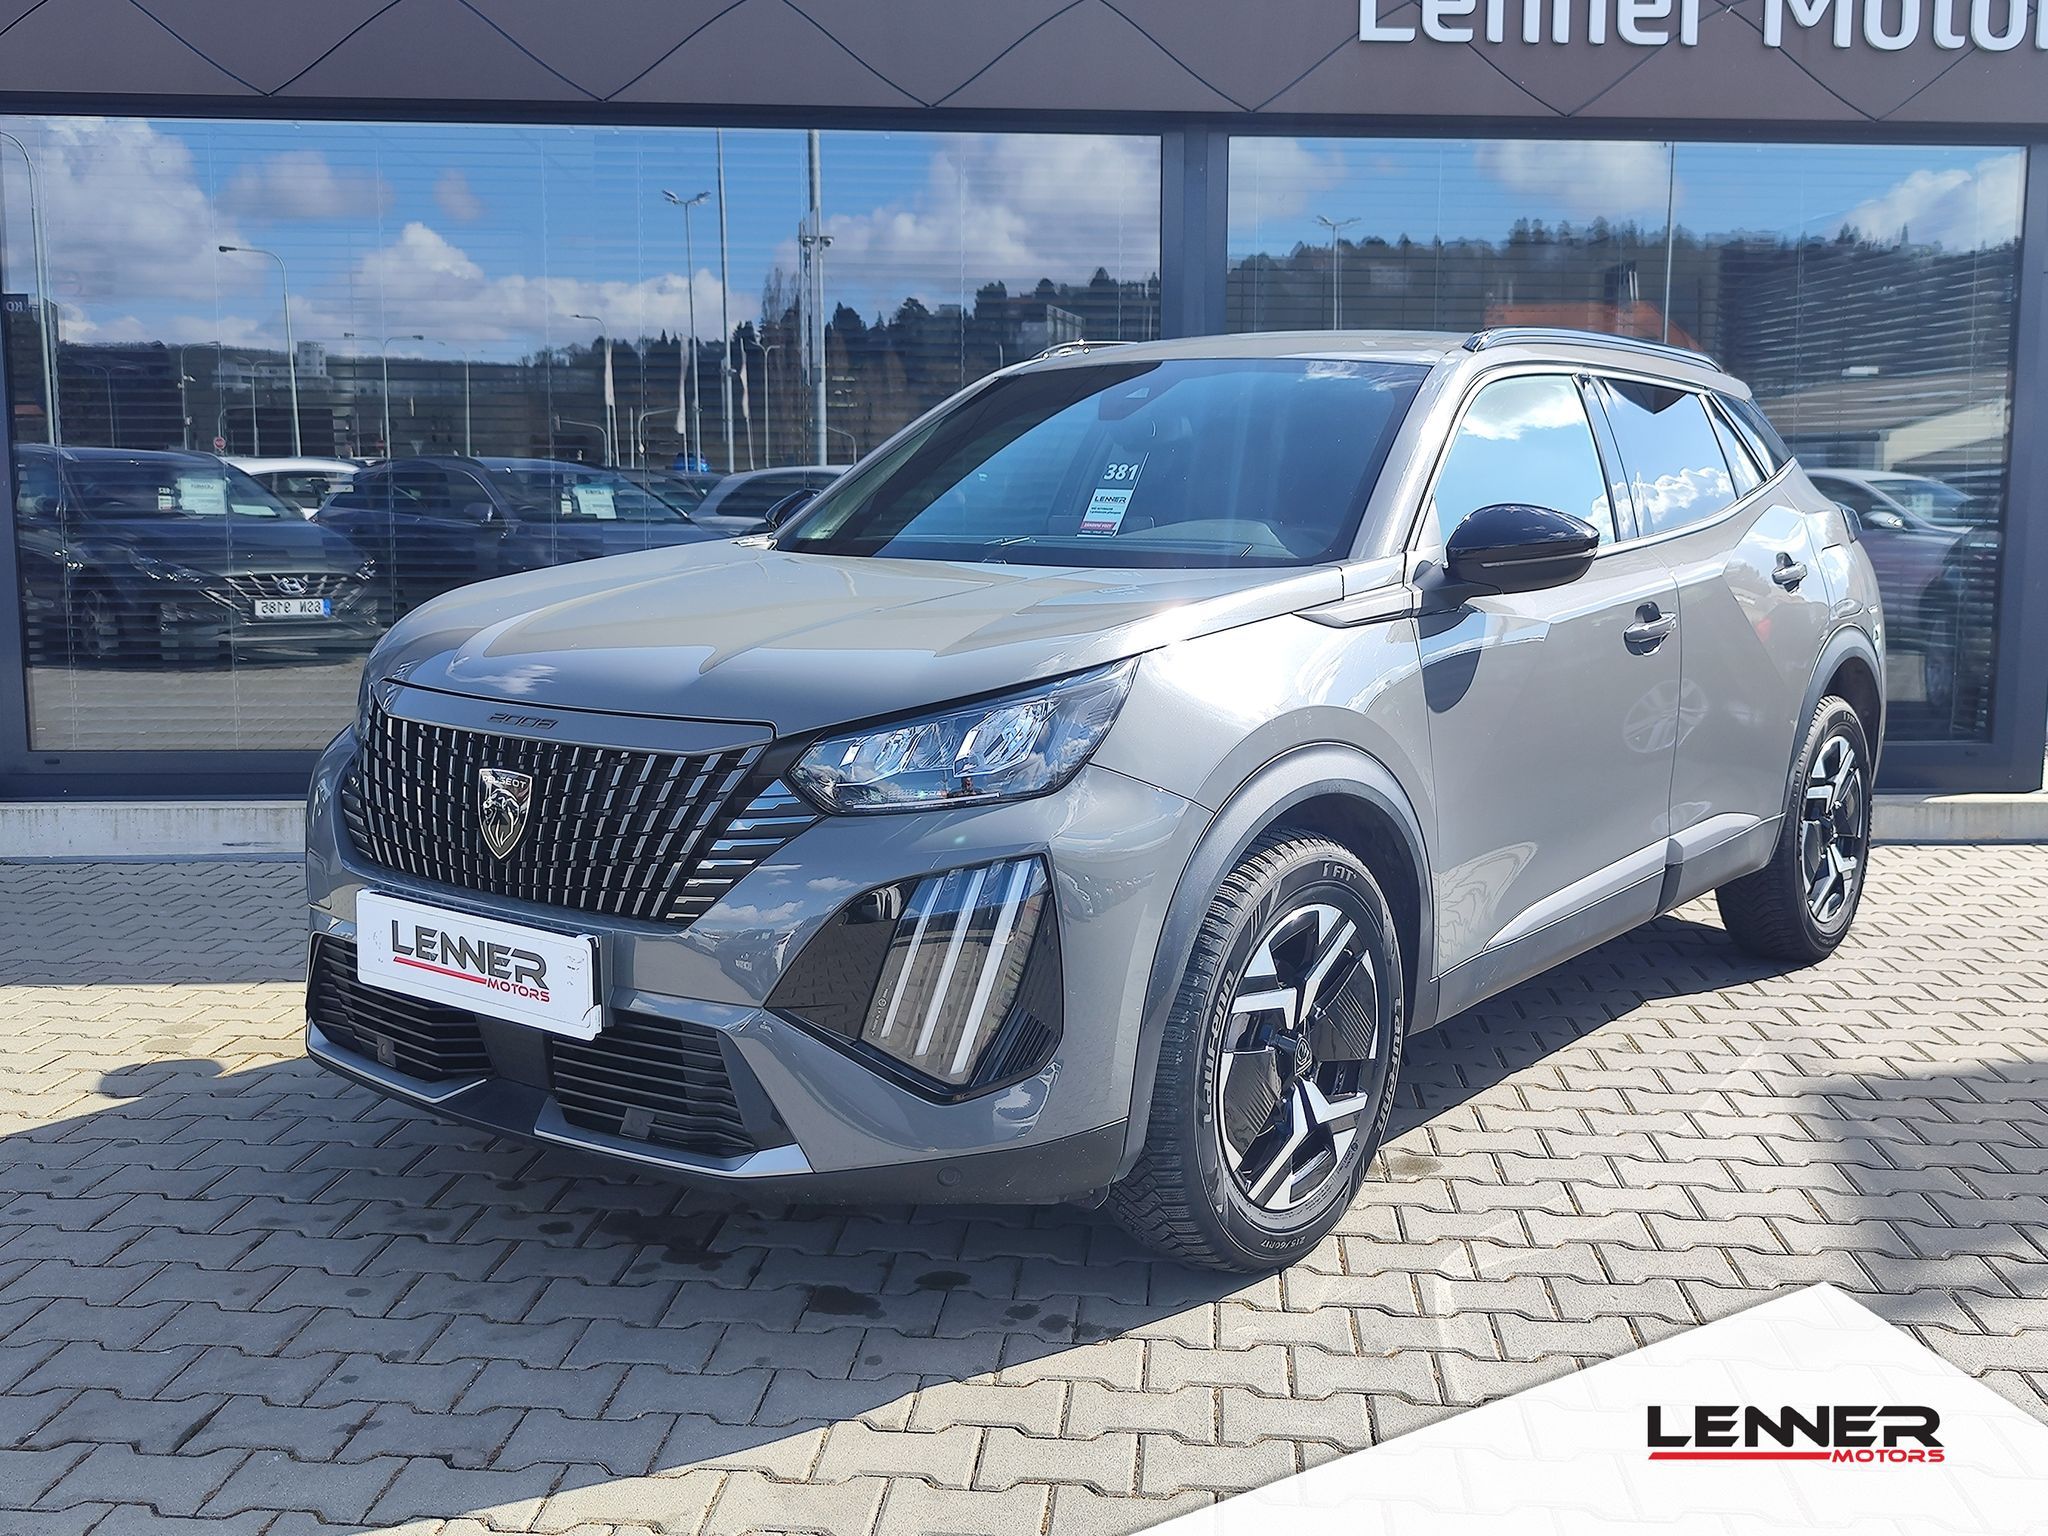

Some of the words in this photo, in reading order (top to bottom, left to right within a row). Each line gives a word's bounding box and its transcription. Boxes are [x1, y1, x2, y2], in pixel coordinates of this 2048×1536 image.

[1104, 464, 1139, 480] 381
[391, 919, 550, 990] LENNER
[486, 977, 551, 1003] MOTORS
